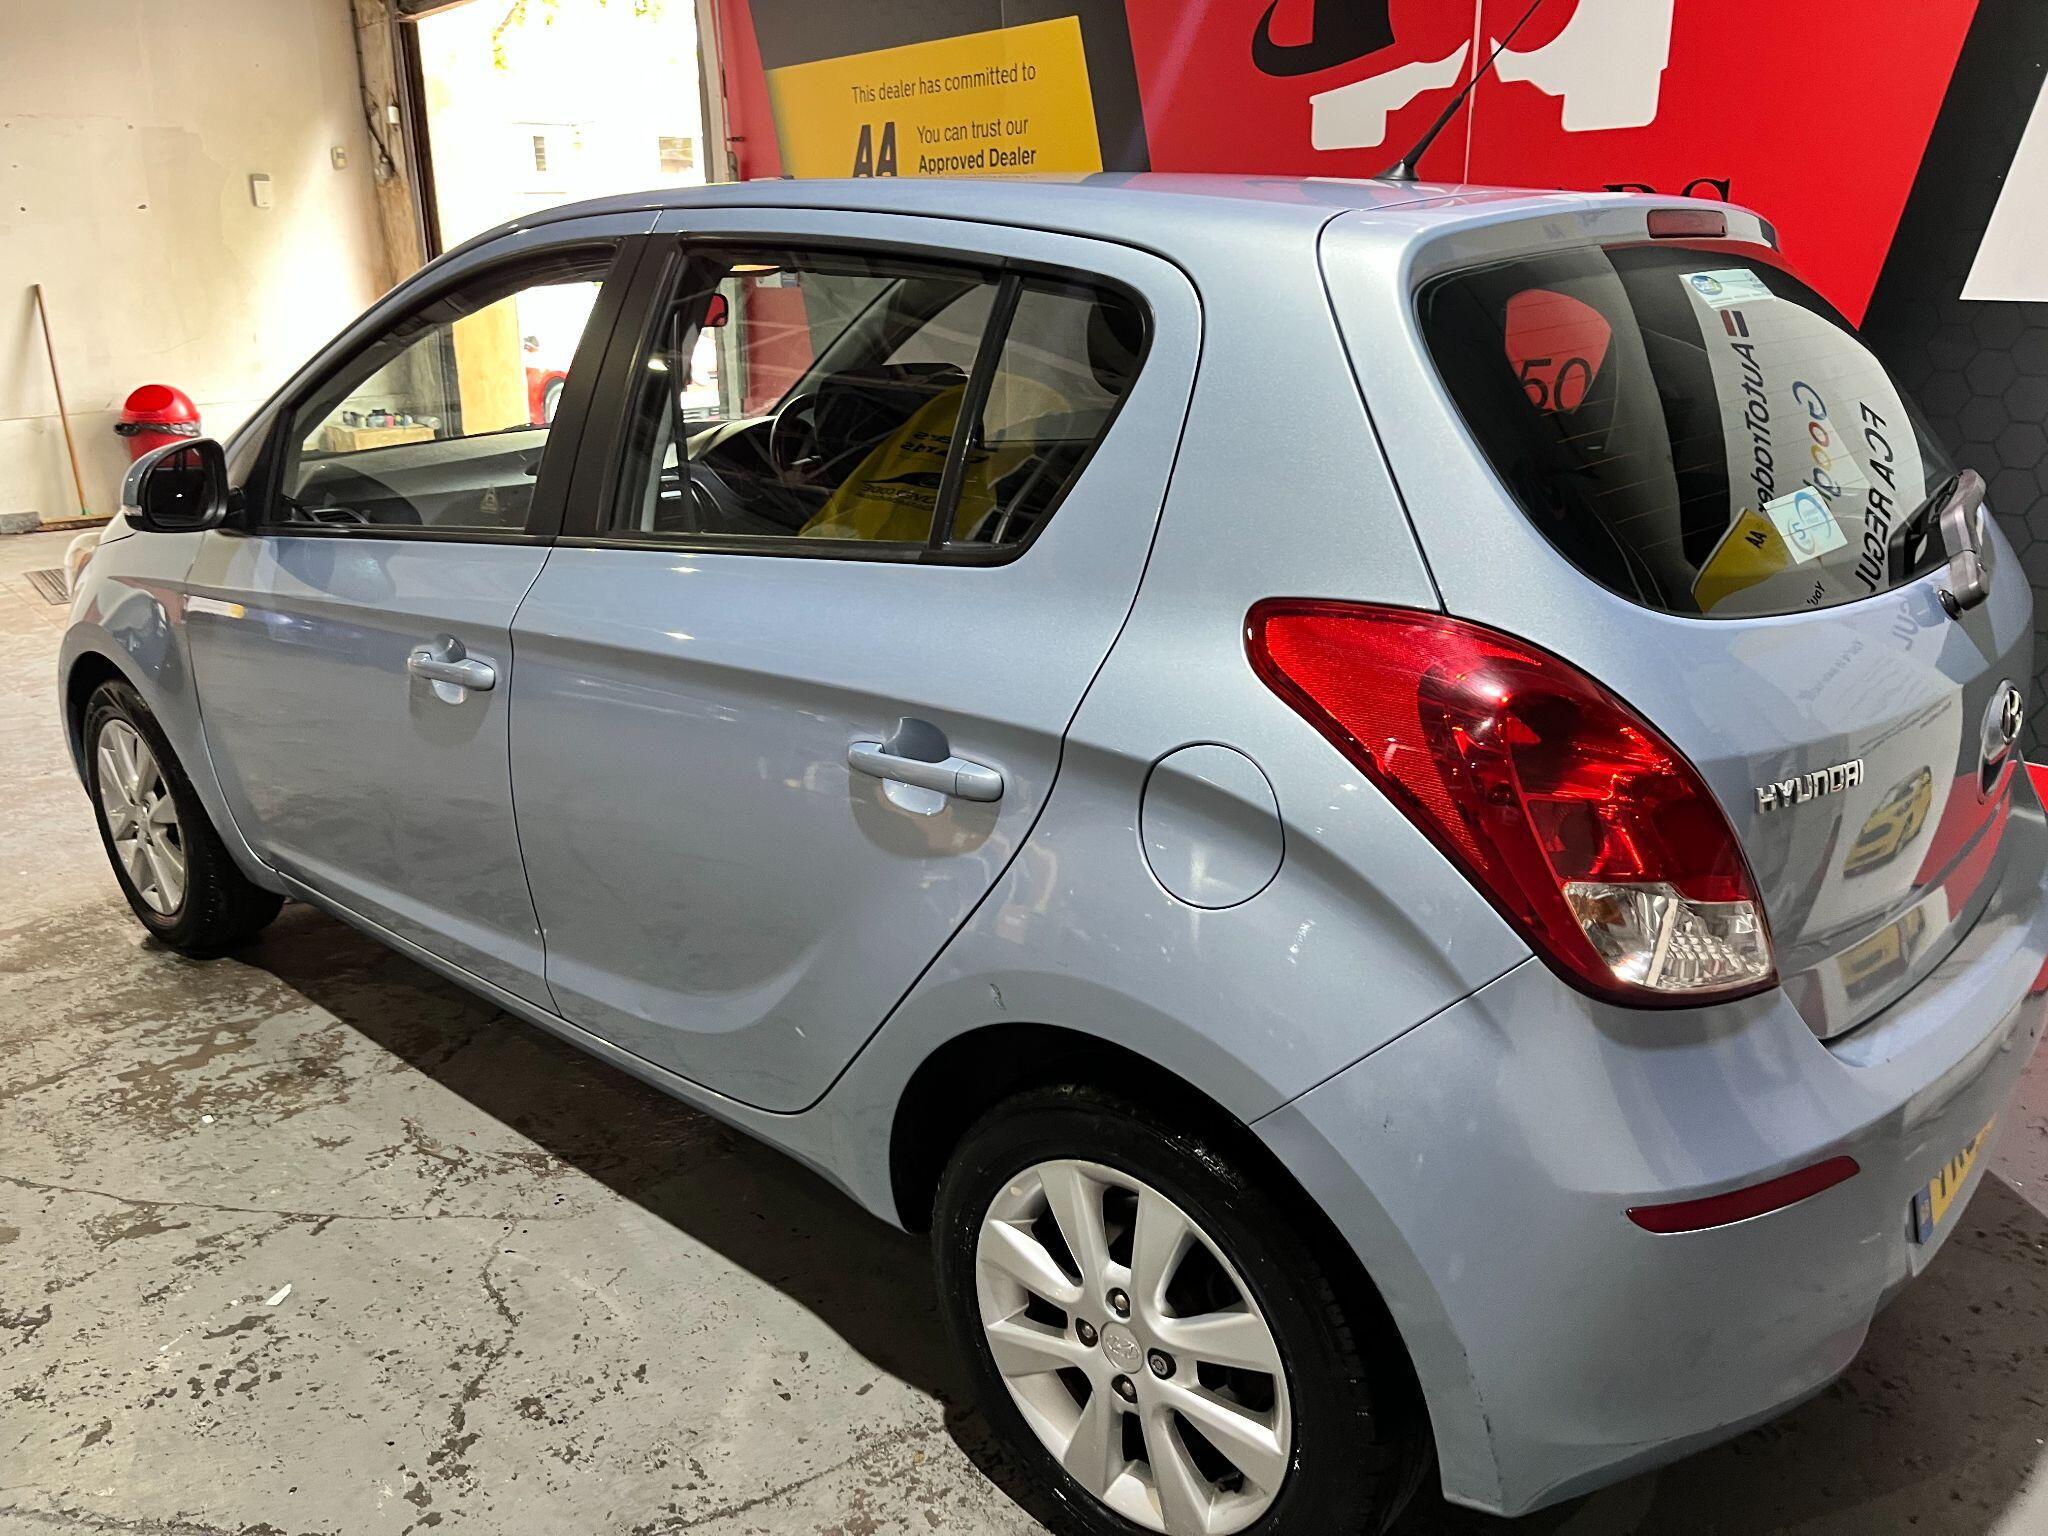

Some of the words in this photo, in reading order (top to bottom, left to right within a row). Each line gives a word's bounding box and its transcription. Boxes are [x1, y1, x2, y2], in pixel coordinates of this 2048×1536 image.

[852, 85, 876, 103] This
[878, 80, 916, 100] dealer
[919, 77, 941, 95] has
[944, 63, 1018, 91] committed
[1022, 61, 1036, 81] to
[853, 121, 897, 177] AA
[917, 126, 940, 143] You
[944, 124, 967, 141] can
[972, 119, 1001, 139] trust
[1006, 119, 1028, 136] our
[919, 149, 984, 174] Approved
[989, 147, 1036, 167] Dealer
[1519, 357, 1593, 411] 50
[1755, 759, 1864, 815] HYUNDAI
